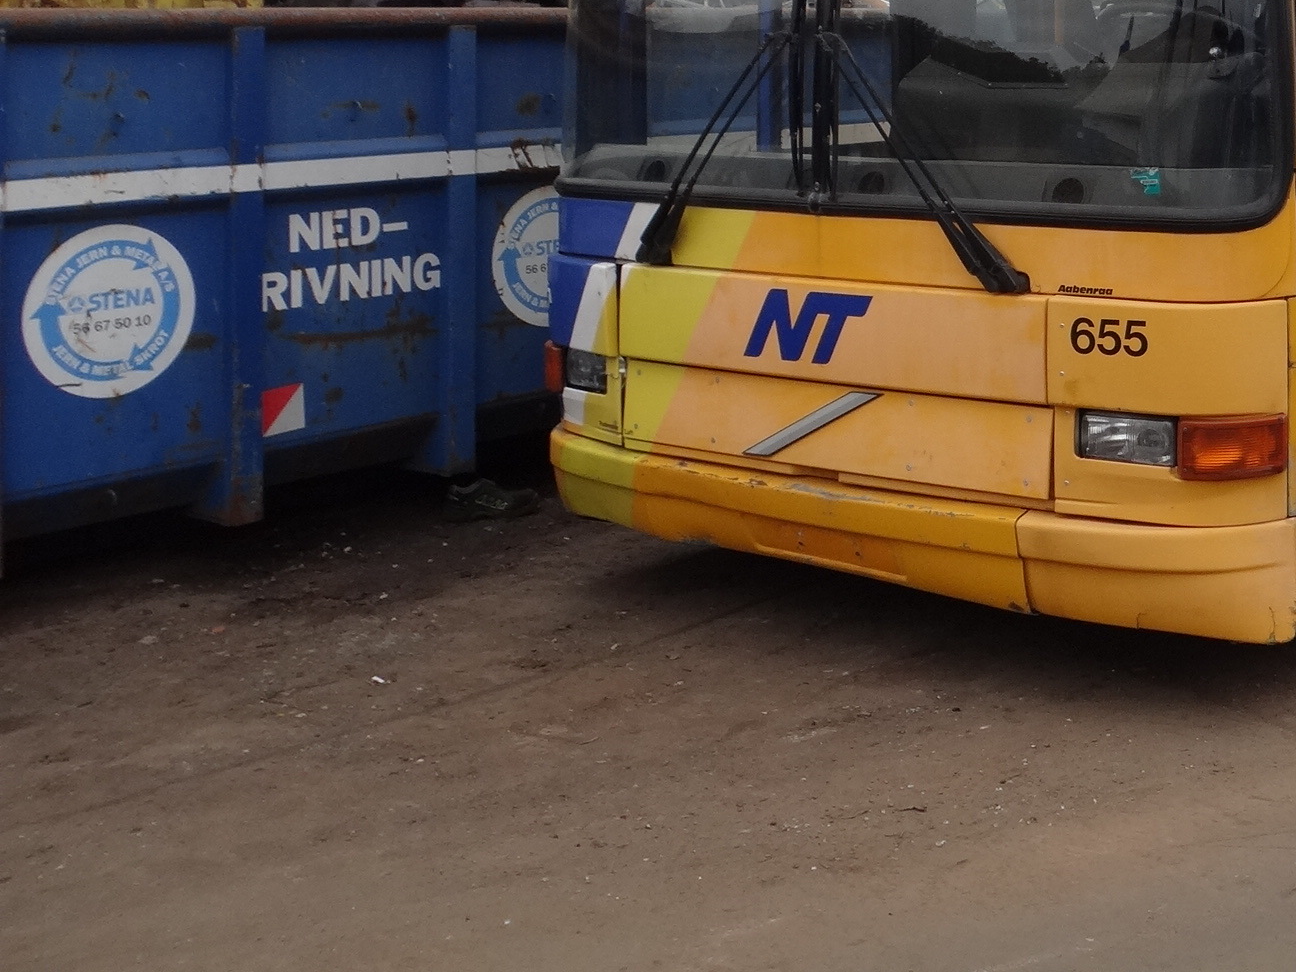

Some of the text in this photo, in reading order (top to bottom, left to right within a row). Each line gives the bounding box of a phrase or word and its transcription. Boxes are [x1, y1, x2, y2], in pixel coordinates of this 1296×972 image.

[289, 207, 409, 253] NED-
[536, 239, 560, 256] STE
[75, 246, 109, 269] JERN
[110, 245, 122, 257] &
[157, 269, 175, 293] A/S
[262, 252, 441, 312] RIVNING
[540, 263, 547, 273] 6
[87, 287, 156, 312] STENA
[1058, 284, 1114, 296] Aabenraa
[94, 319, 111, 332] 67
[114, 317, 132, 330] 50
[135, 314, 152, 327] 10
[743, 288, 873, 364] NT
[1070, 317, 1148, 357] 655
